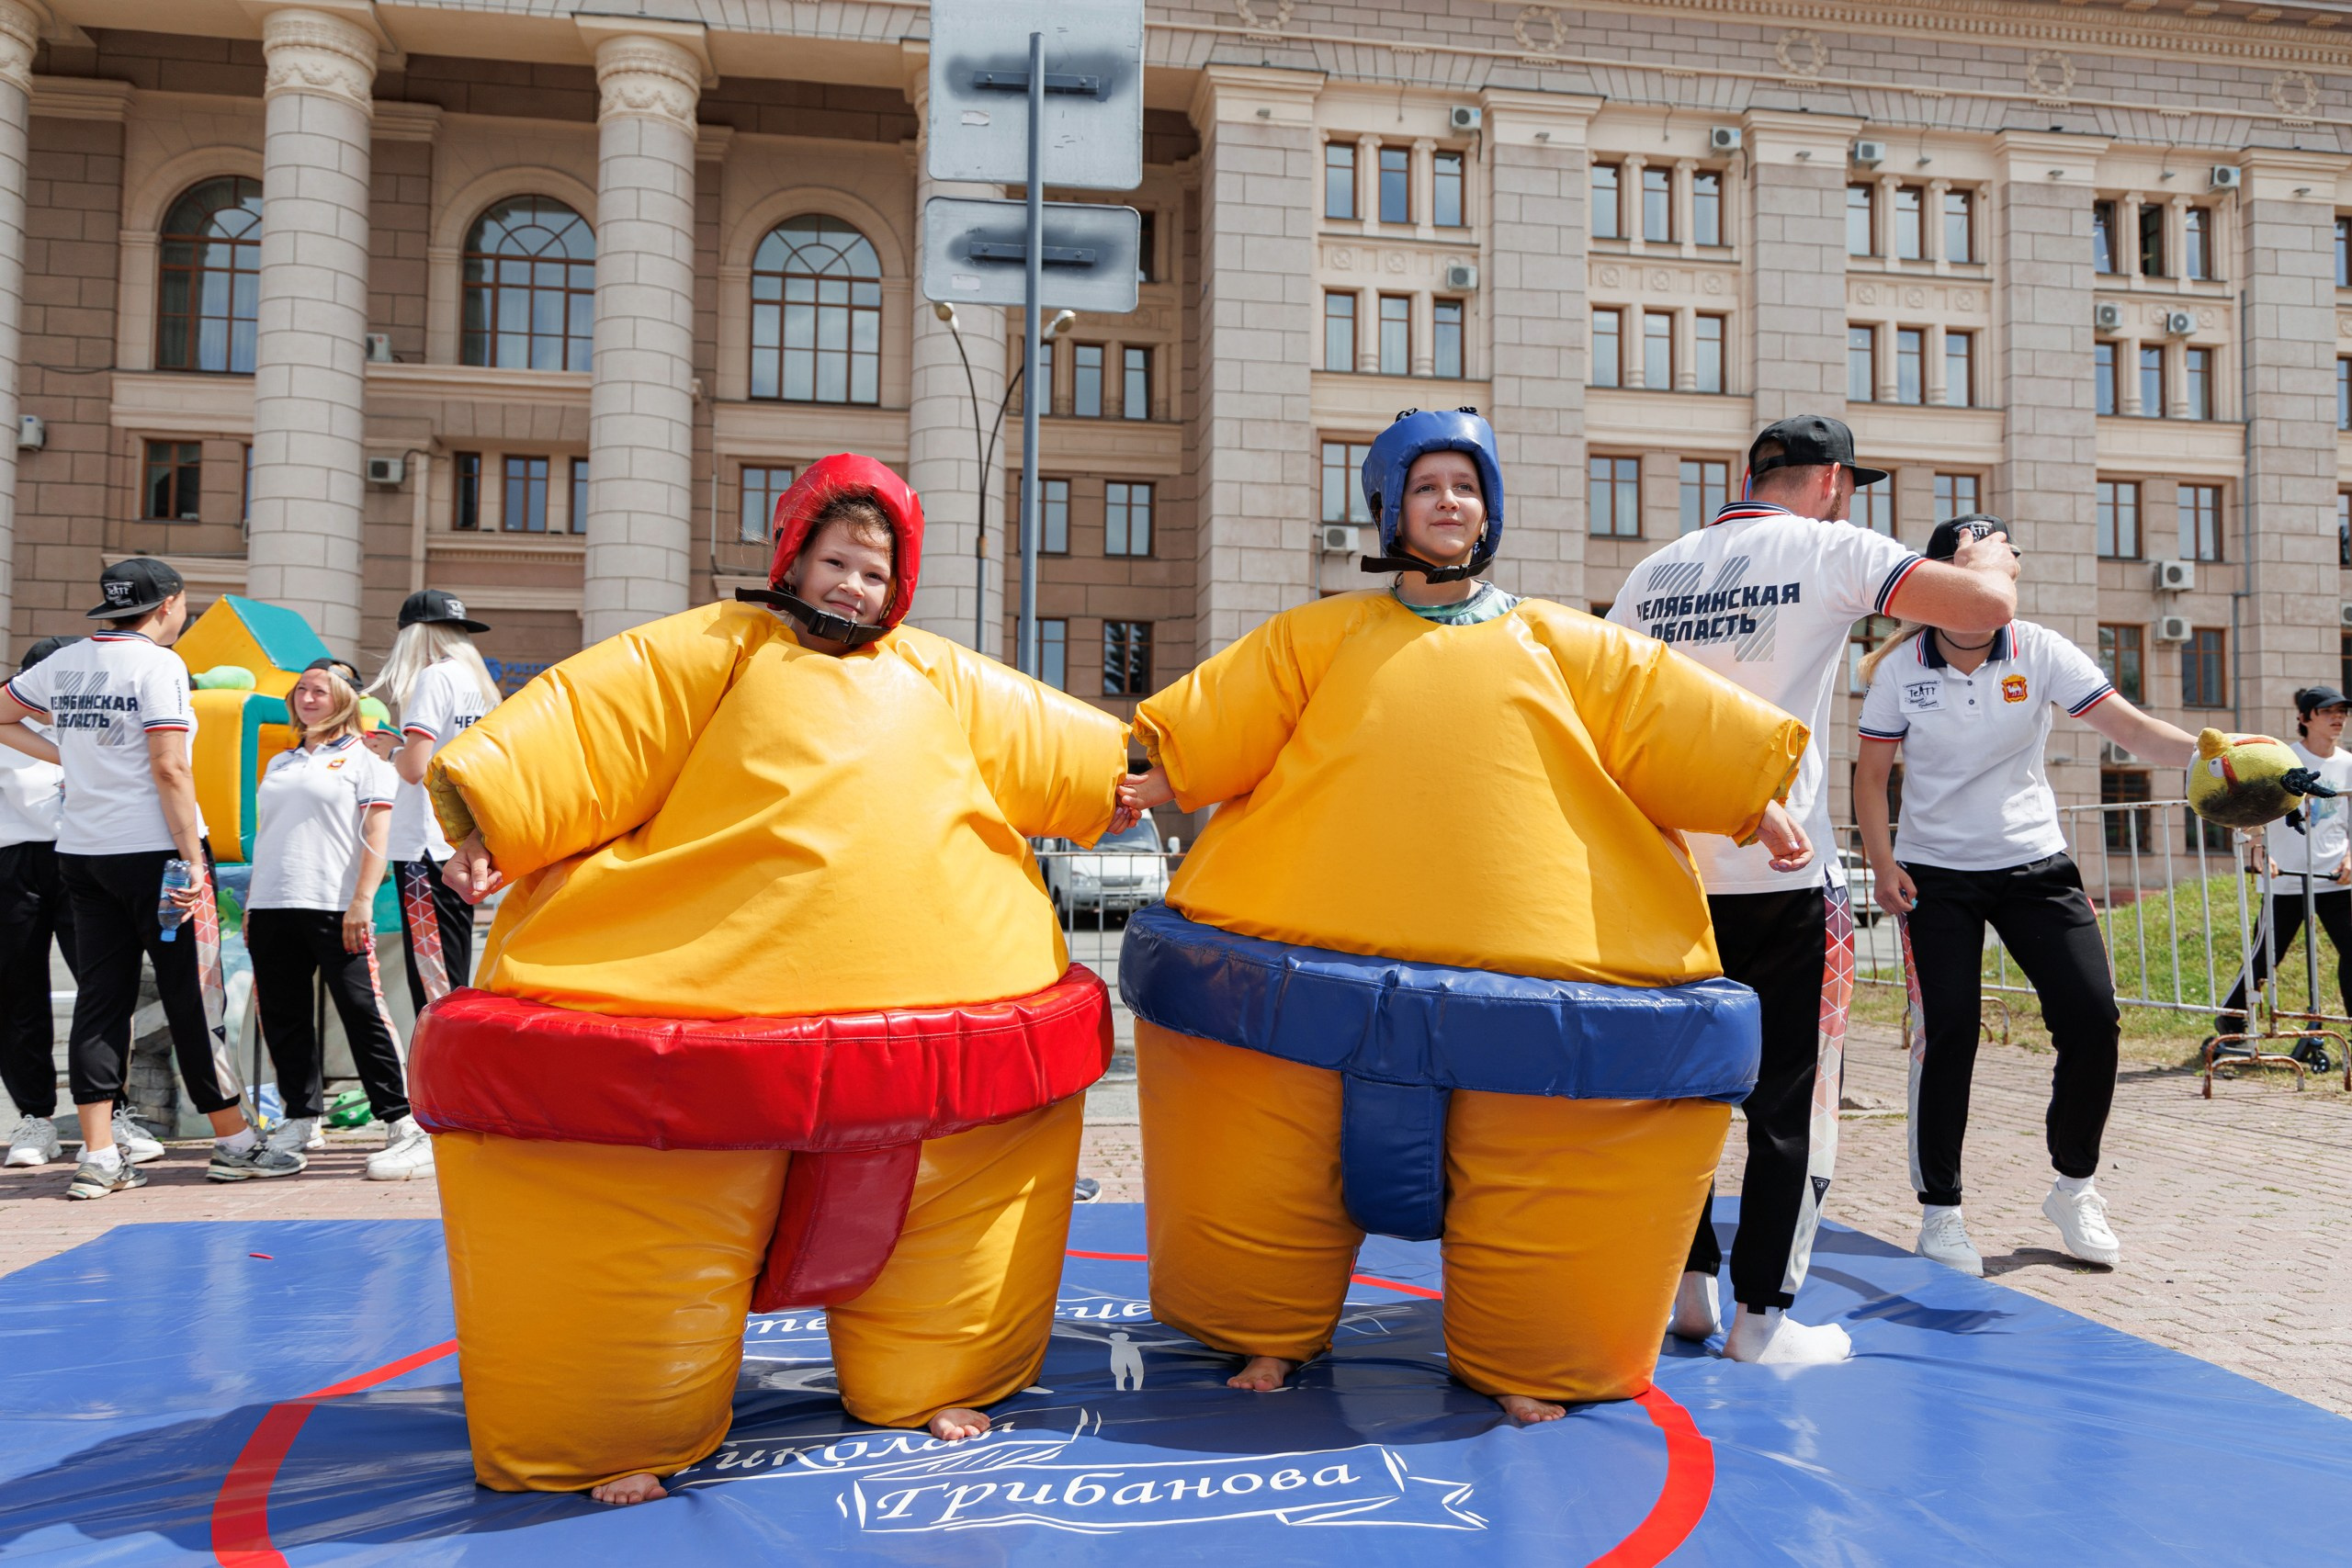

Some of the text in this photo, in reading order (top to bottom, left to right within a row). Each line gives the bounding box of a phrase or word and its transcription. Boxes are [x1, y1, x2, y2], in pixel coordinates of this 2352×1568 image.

[1651, 613, 1757, 643] ОБЛАСТЬ
[56, 712, 110, 728] ОБЛАСТЬ
[674, 1422, 1015, 1477] икола
[876, 1462, 1361, 1525] Грибанова
